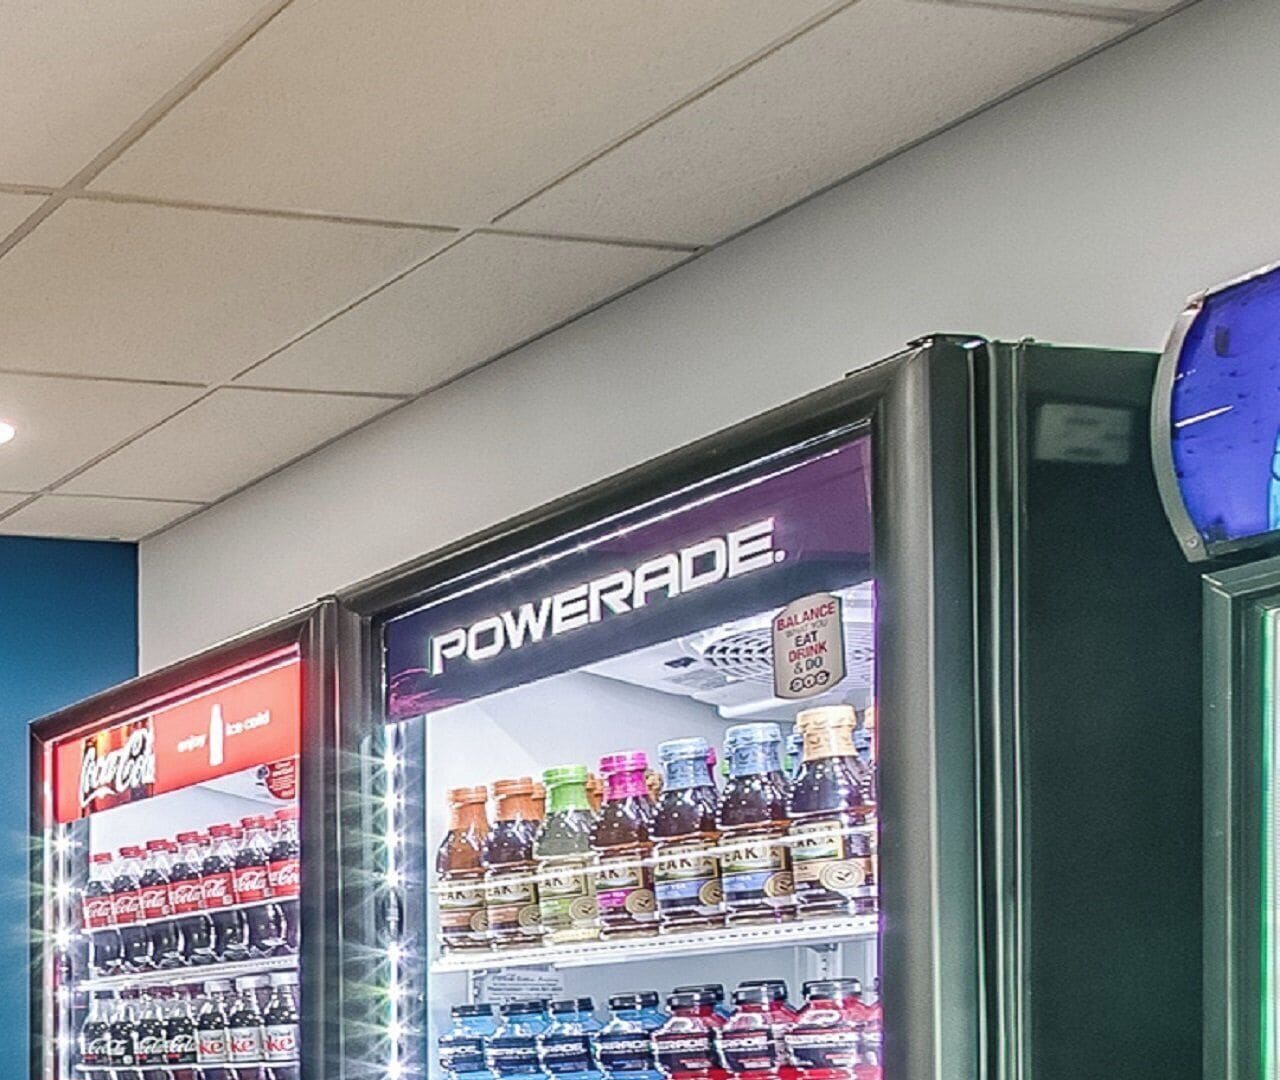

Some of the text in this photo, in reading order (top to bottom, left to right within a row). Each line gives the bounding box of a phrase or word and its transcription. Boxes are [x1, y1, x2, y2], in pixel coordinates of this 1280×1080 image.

[777, 602, 835, 631] BALANCE
[810, 619, 827, 629] YOU
[795, 630, 817, 647] EAT
[788, 640, 827, 662] DRINK
[794, 656, 823, 674] & DO
